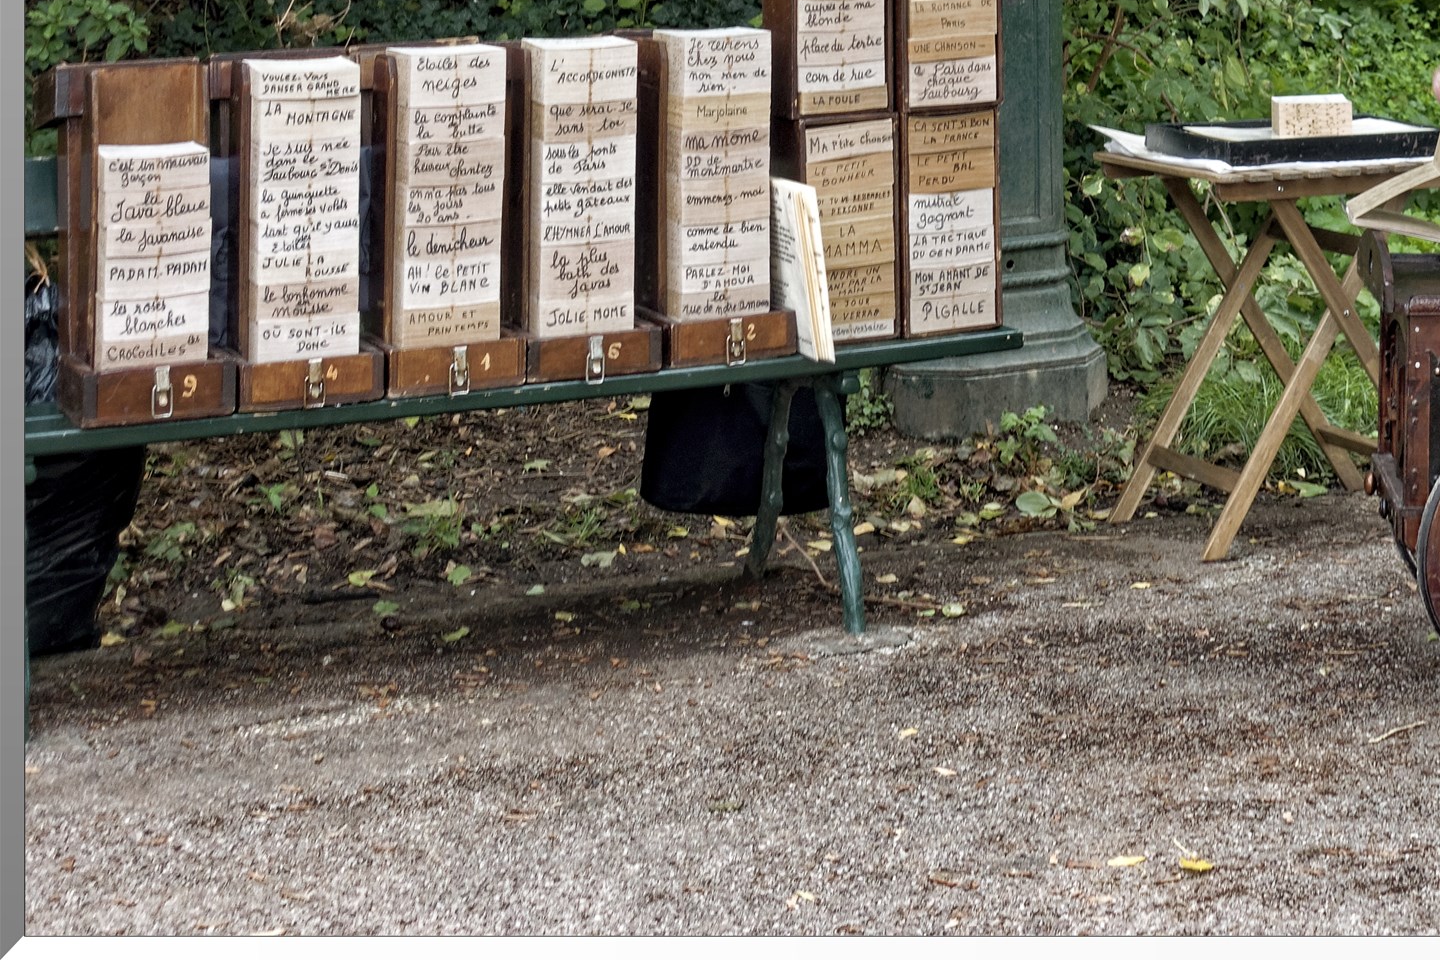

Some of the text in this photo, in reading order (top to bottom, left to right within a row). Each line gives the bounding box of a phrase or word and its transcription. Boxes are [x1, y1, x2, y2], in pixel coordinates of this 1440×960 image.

[913, 40, 977, 54] UNE CHANSON
[752, 66, 767, 78] de
[265, 100, 282, 117] LA
[813, 97, 826, 106] LA
[286, 109, 357, 126] MONTAGNE
[696, 103, 748, 124] Marjolaine
[944, 132, 980, 145] FRANCE
[916, 154, 931, 167] LE
[952, 160, 976, 174] BAL
[840, 224, 856, 239] LA
[912, 228, 989, 248] LA TACTIQUE
[406, 230, 420, 258] le
[912, 250, 926, 260] DU
[914, 265, 991, 285] MON AMANT DE
[546, 304, 628, 328] JOLIE MOME
[922, 299, 986, 322] PIGALLE
[746, 323, 757, 341] 2
[607, 341, 622, 360] 6
[480, 352, 491, 371] 1
[182, 374, 198, 398] 9
